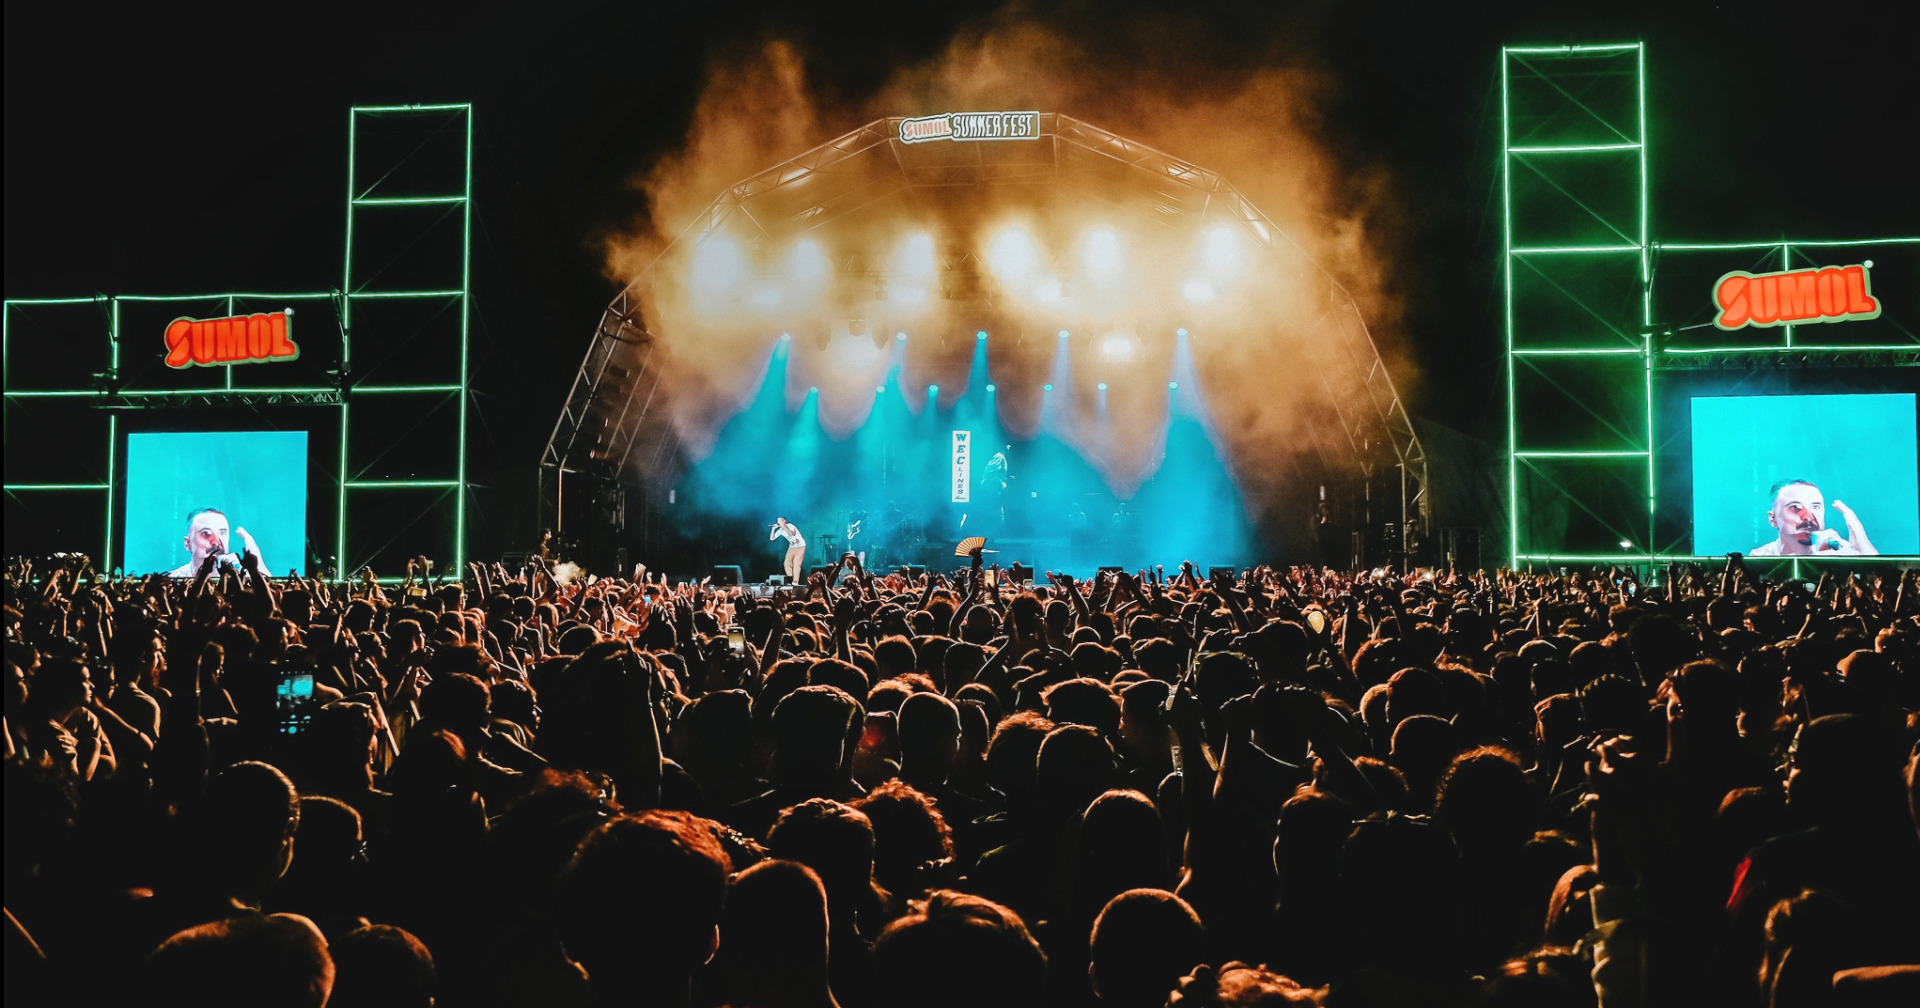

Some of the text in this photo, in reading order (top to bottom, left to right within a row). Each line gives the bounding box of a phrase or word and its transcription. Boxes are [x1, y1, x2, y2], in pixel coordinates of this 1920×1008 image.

[904, 114, 1033, 138] SUMOL SUMMERFEST
[1719, 266, 1876, 327] SUMOL
[165, 312, 296, 367] SUMOL
[955, 433, 968, 465] WEC
